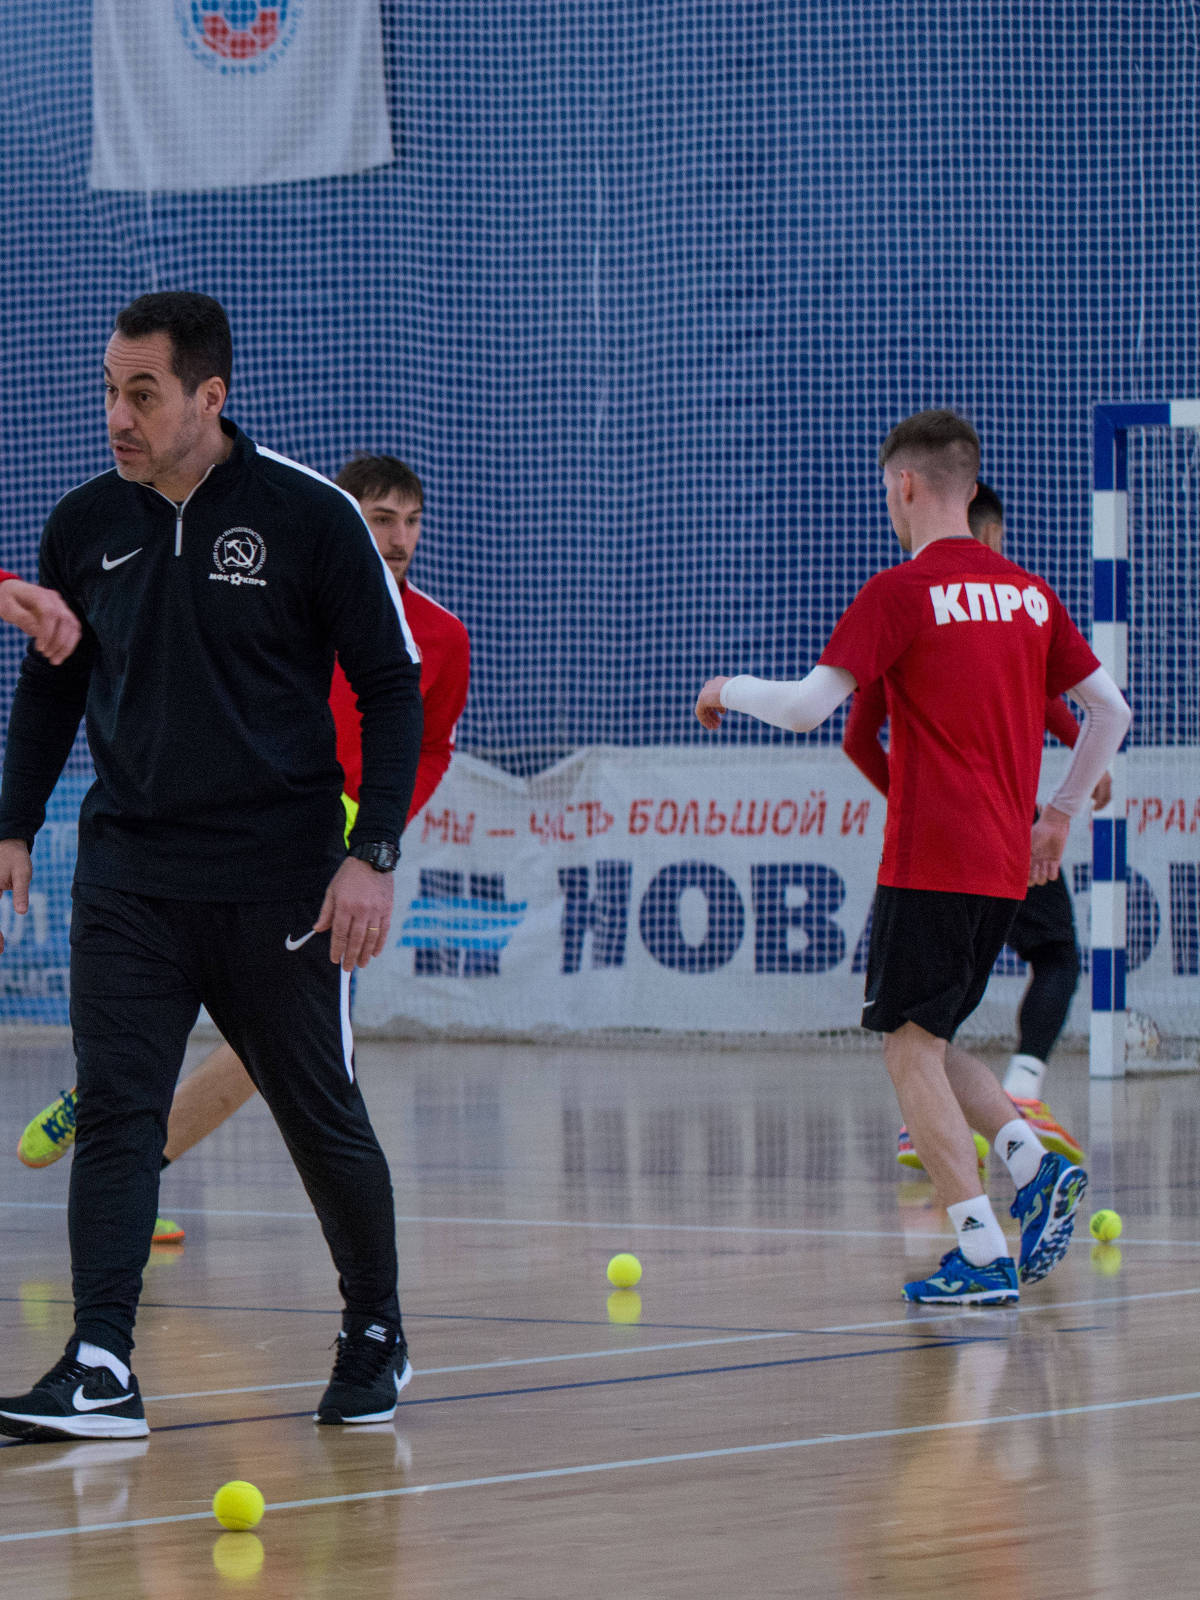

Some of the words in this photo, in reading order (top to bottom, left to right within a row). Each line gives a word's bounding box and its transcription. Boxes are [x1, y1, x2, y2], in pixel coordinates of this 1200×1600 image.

[929, 582, 1049, 627] КПРФ
[421, 808, 476, 844] МЫ
[628, 790, 827, 837] БОЛЬШОЙ
